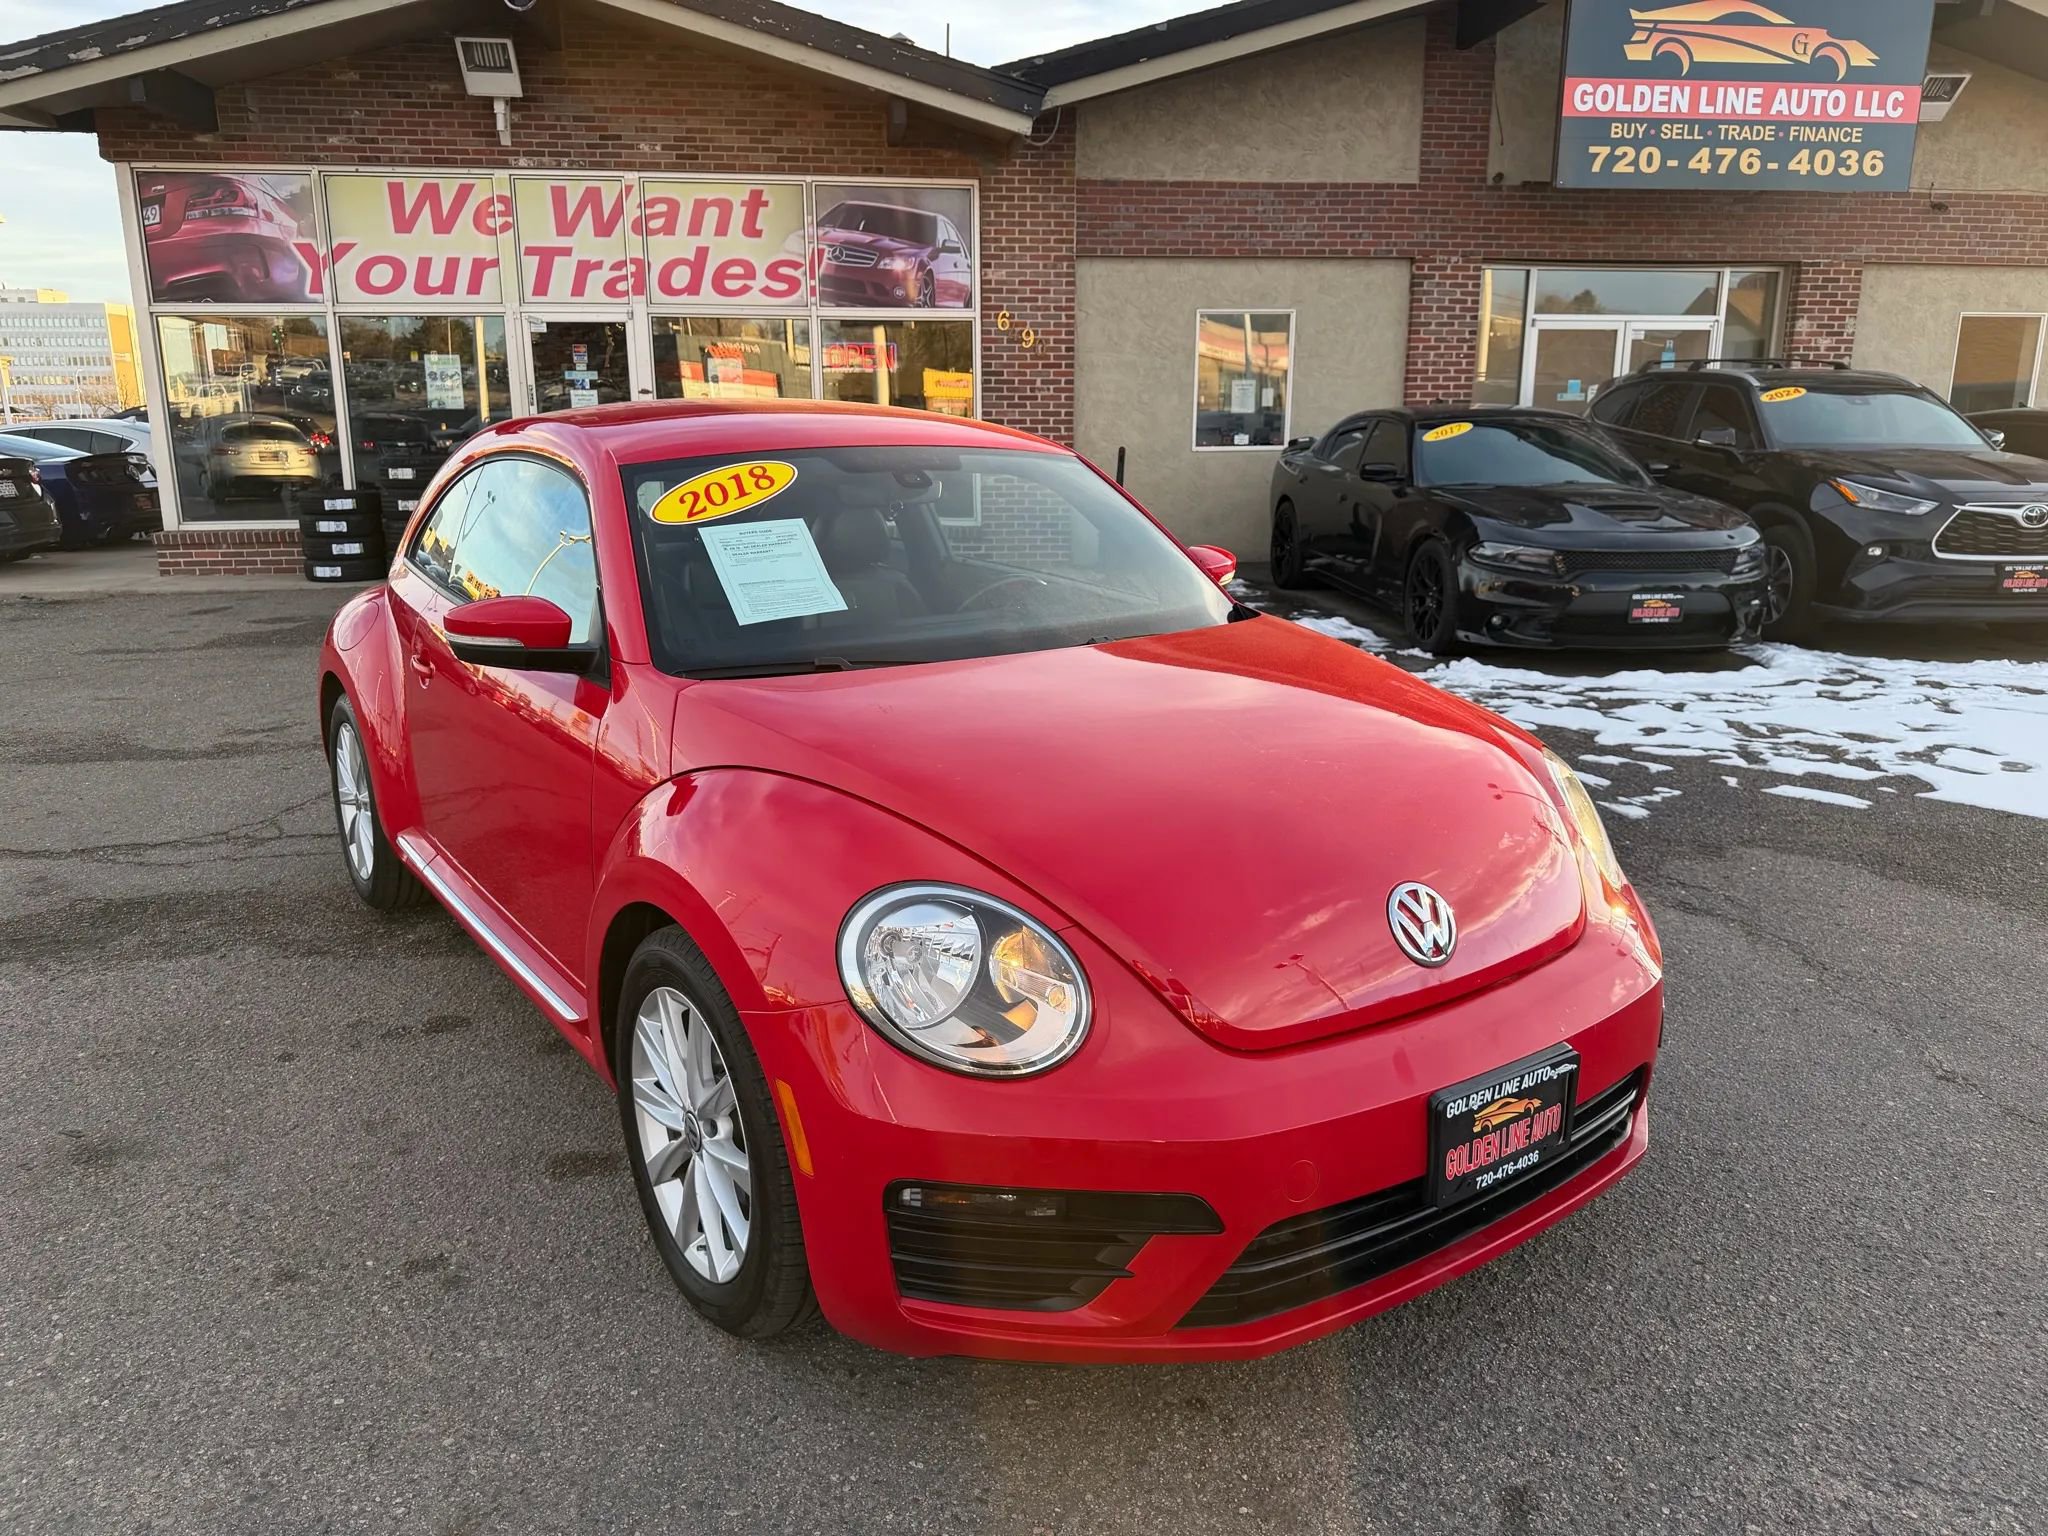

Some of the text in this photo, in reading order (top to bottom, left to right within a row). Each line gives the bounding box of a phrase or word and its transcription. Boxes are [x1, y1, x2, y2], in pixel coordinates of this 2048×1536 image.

[1573, 83, 1905, 118] GOLDEN LINE AUTO LLC
[1610, 122, 1863, 143] BUY SELL TRADE FINANCE
[387, 182, 770, 239] We Want
[292, 242, 826, 299] Your Trades!
[829, 343, 896, 369] OPEN
[1765, 388, 1803, 401] 2024
[1431, 423, 1464, 440] 2017
[679, 465, 776, 519] 2018
[1446, 1066, 1551, 1118] GOLDEN LINE AUTO
[1445, 1103, 1562, 1181] GOLDEN LINE AUTO
[1475, 1150, 1540, 1190] 720-476-4036
